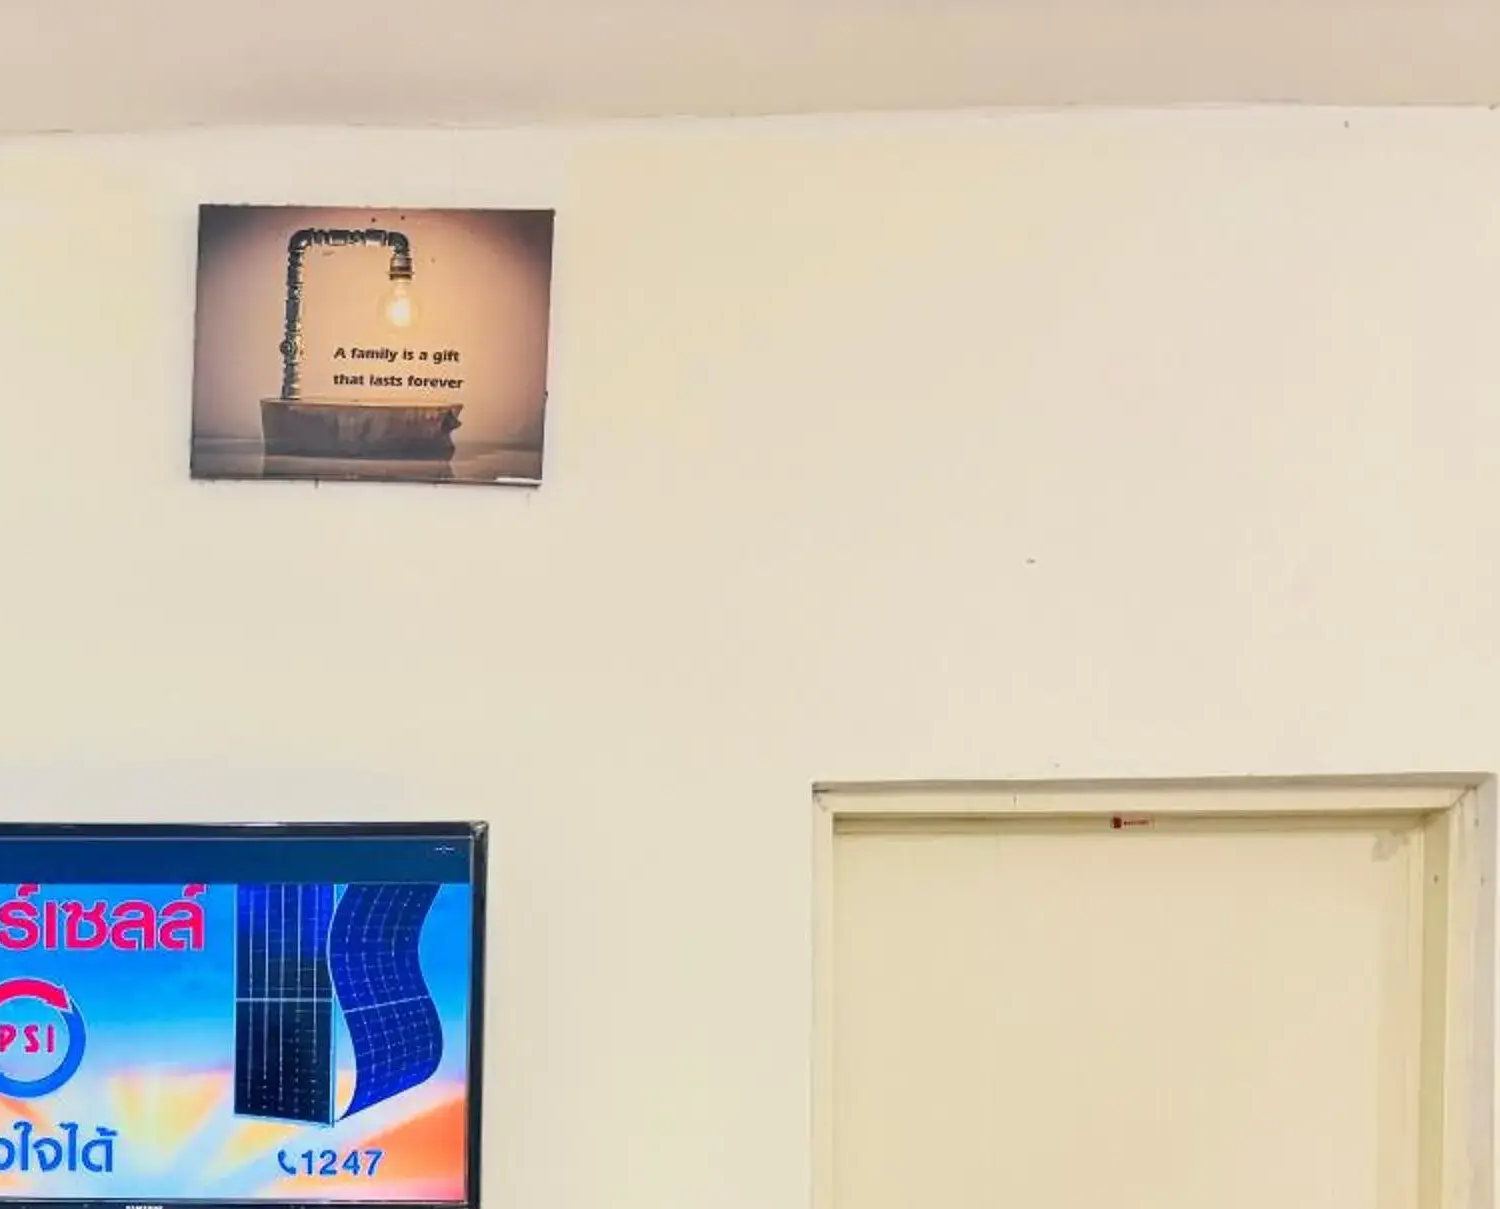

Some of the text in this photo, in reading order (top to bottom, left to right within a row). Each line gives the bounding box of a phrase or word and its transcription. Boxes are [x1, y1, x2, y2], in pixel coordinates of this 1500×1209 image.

[333, 347, 460, 365] A family is a gift
[333, 374, 464, 389] that lasts forever
[301, 1149, 383, 1176] 1247
